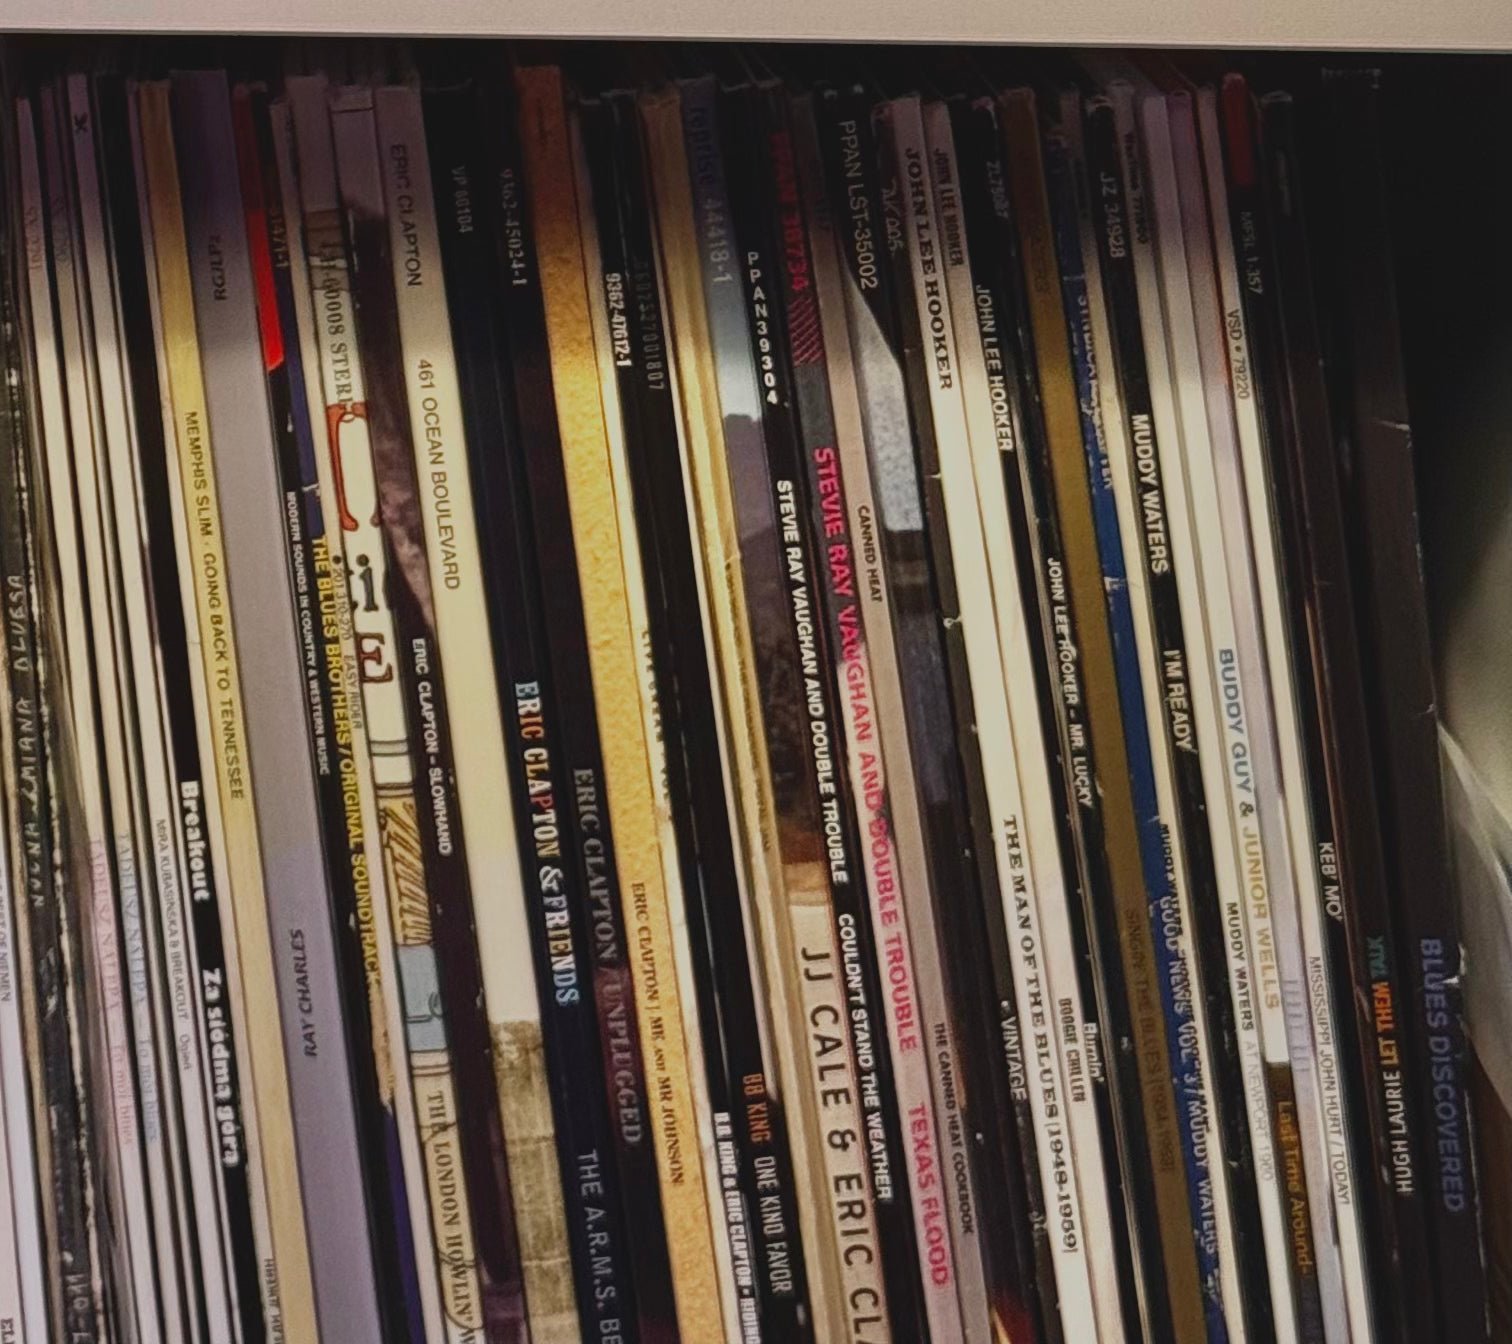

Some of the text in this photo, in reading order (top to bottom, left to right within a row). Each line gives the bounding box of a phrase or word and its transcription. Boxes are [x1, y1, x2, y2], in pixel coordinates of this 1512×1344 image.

[390, 142, 422, 286] ERIC CLAPTON
[901, 146, 954, 390] JOHN LEE HOOKER
[1097, 170, 1127, 258] JZ 34928
[605, 272, 632, 366] 9362-47612-1
[971, 284, 1017, 450] JOHN LEE HOOKER
[1225, 306, 1250, 398] VSD 79220
[415, 358, 461, 590] 461 OCEAN BOULEVARD
[854, 504, 884, 602] CANNED HEAT
[1132, 412, 1172, 572] MUDDY WATERS
[183, 410, 243, 800] MEMPHIS SLIM GOING BACK TO TENNESSEE
[774, 480, 849, 884] STEVIE RAY VAUGHAN AND DOUBLE TROUBLE
[411, 638, 452, 854] ERIC CLAPTON SLOWHAND
[813, 446, 918, 1052] STEVIE RAY VAUGHAN AND DOUBLE TROUBLE
[1161, 648, 1193, 750] I'M READY
[179, 778, 209, 902] Breakout
[513, 680, 580, 1004] ERIC CLAPTON & FRIENDS
[1217, 648, 1282, 1010] BUDDY GUY & JUNIOR WELLS
[1316, 840, 1341, 920] KEB' MO'
[201, 966, 225, 1002] Za
[290, 928, 317, 1056] RAY CHARLES
[836, 912, 892, 1198] COULDN'T STAND THE WEATHER
[997, 1016, 1032, 1100] VINTAGE
[1365, 936, 1412, 1192] HUGH LAURIE LET THEM TALK
[800, 946, 872, 1266] JJ CALE & ERIC
[1415, 936, 1470, 1212] BLUES DISCOVERED
[577, 1148, 618, 1308] THE A.R.M.S.
[739, 1072, 795, 1292] BB KING ONE KIND FAVOR
[907, 1100, 950, 1286] TEXAS FLOOD
